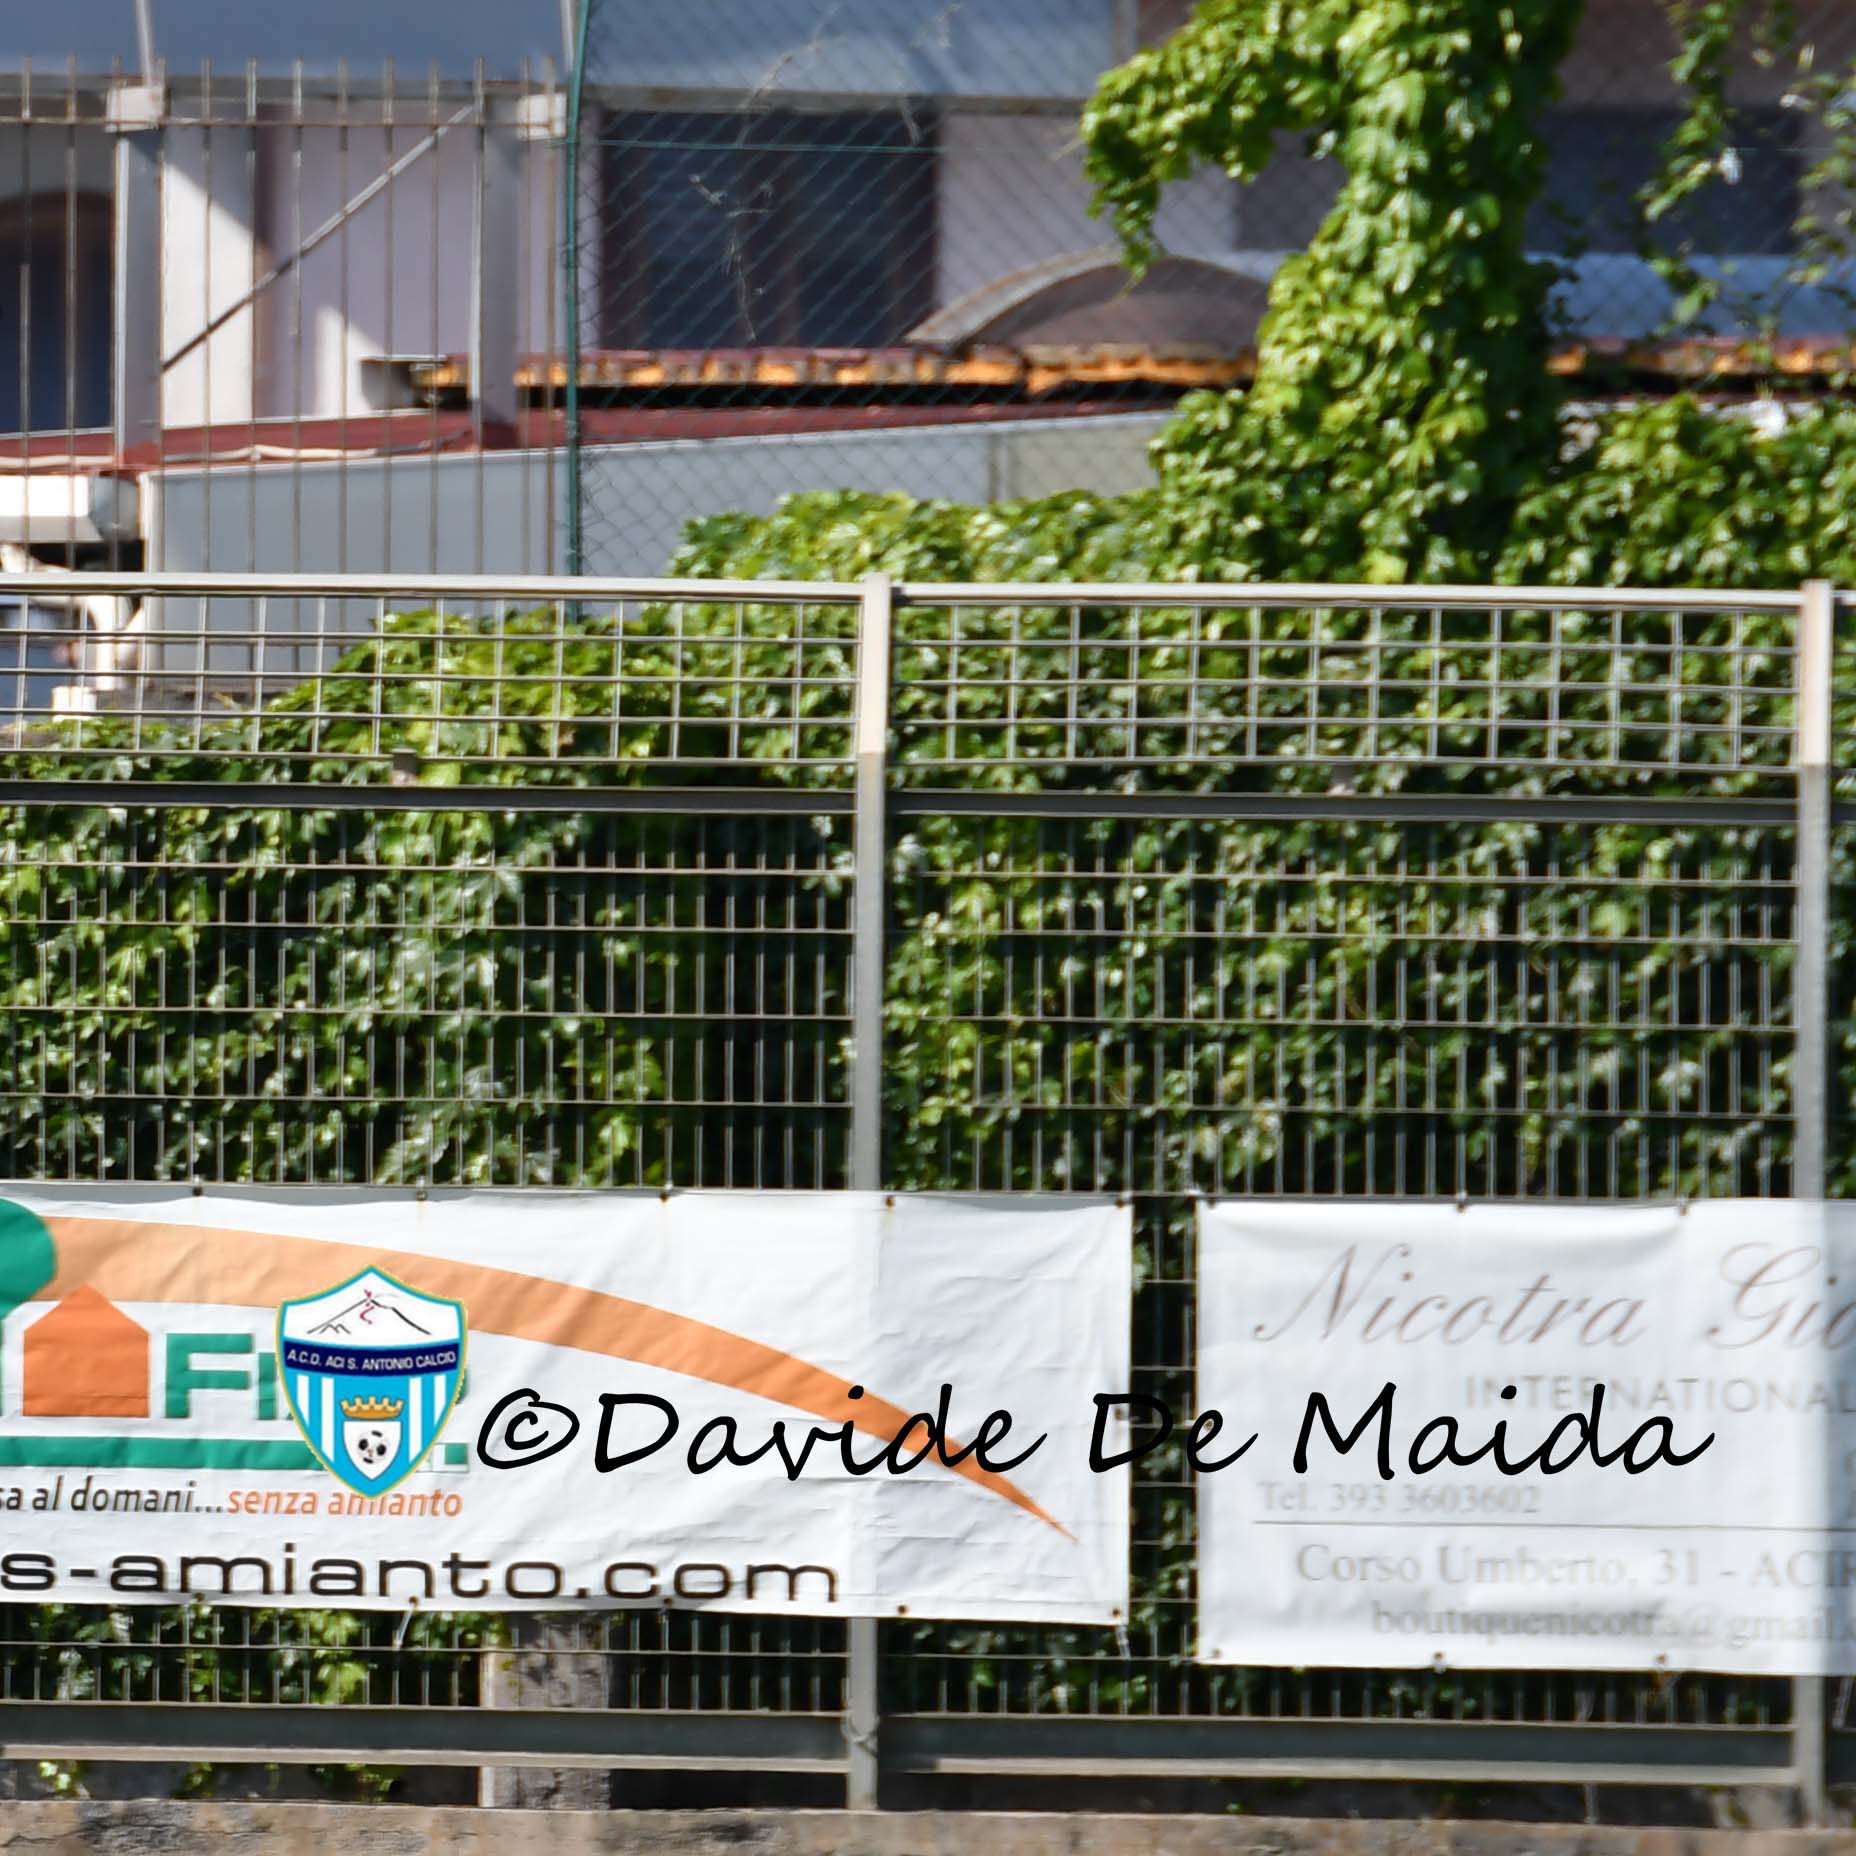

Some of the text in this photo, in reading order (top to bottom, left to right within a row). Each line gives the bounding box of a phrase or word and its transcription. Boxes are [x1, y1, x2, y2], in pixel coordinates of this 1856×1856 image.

[1254, 1242, 1648, 1346] Nicotra
[32, 1475, 61, 1511] al
[326, 1486, 464, 1518] amianto
[1258, 1482, 1542, 1515] Tel. 393 3603602
[1297, 1544, 1422, 1583] Corso
[1438, 1546, 1639, 1589] Umberto,
[1657, 1549, 1701, 1586] 31
